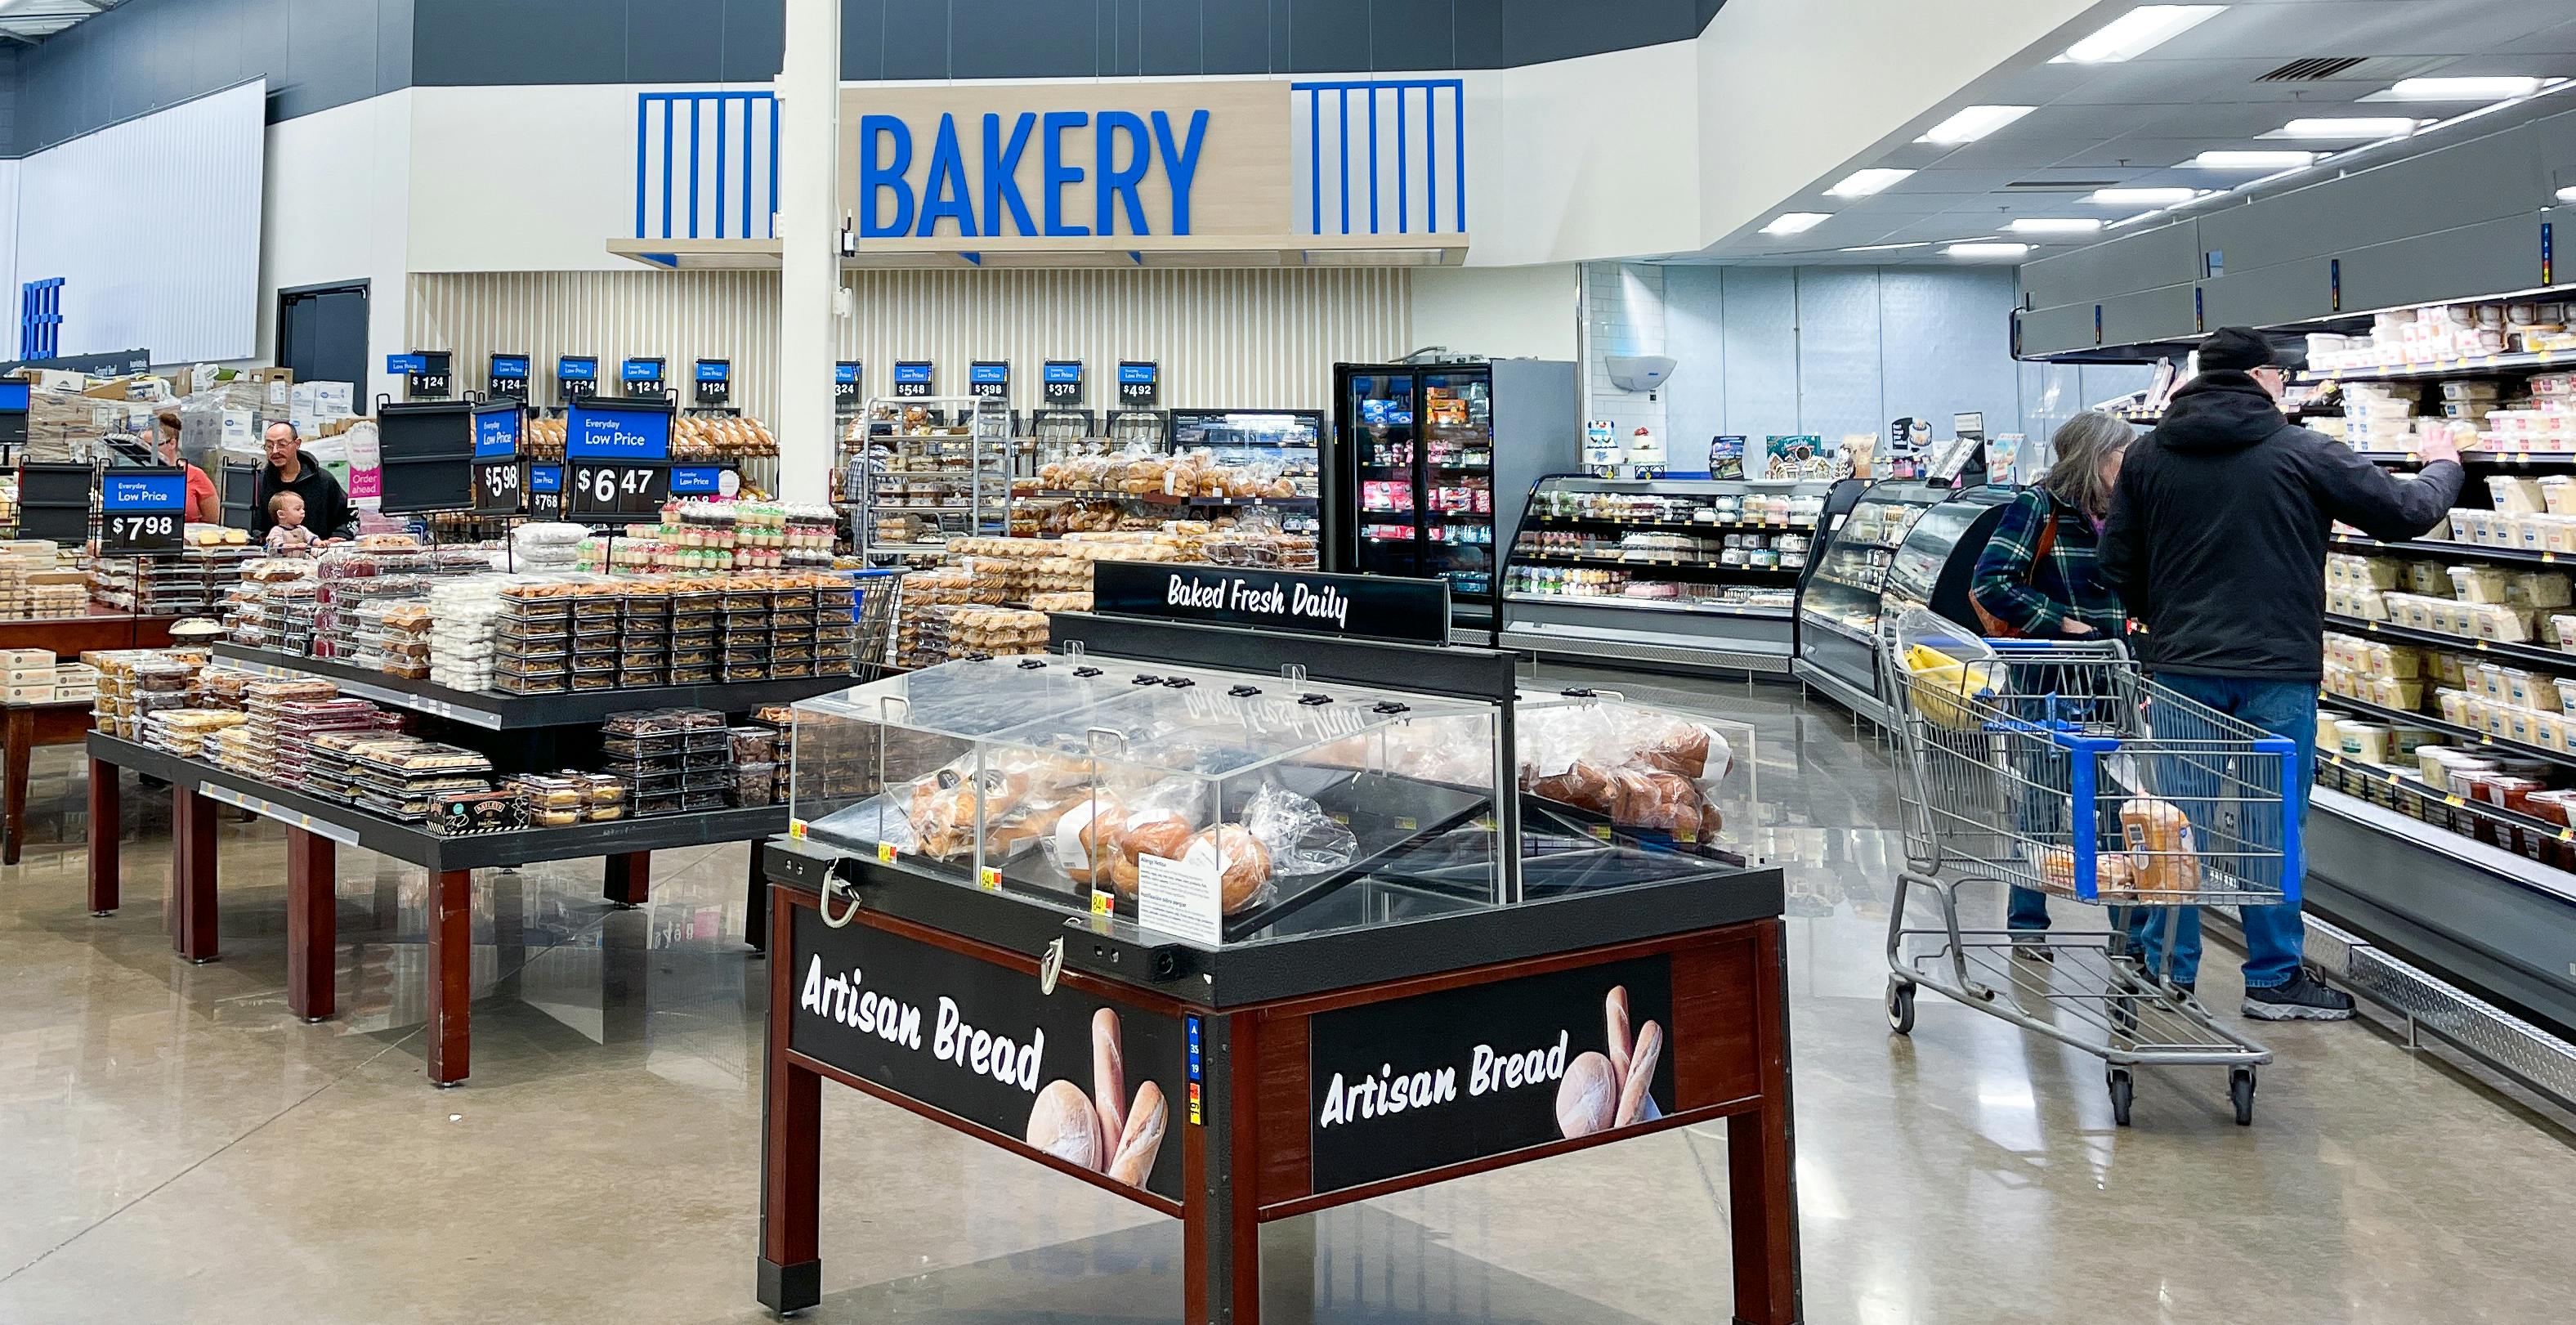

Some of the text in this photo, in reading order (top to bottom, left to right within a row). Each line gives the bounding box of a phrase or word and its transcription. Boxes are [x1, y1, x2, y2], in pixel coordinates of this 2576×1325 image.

[860, 110, 1210, 237] BAKERY
[20, 277, 65, 360] BEEF
[585, 419, 619, 430] Everyday
[484, 432, 512, 445] Low Price
[585, 432, 646, 446] Low Price
[118, 482, 147, 490] Everyday
[353, 474, 378, 484] Order
[485, 465, 517, 497] $598
[118, 491, 167, 501] Low Price
[351, 484, 376, 494] ahead
[534, 494, 557, 511] $768
[113, 517, 172, 541] $798
[1167, 574, 1348, 629] Baked Fresh Daily
[801, 953, 1044, 1094] Artisan Bread
[1192, 1025, 1198, 1034] A
[1321, 1030, 1568, 1128] Artisan Bread
